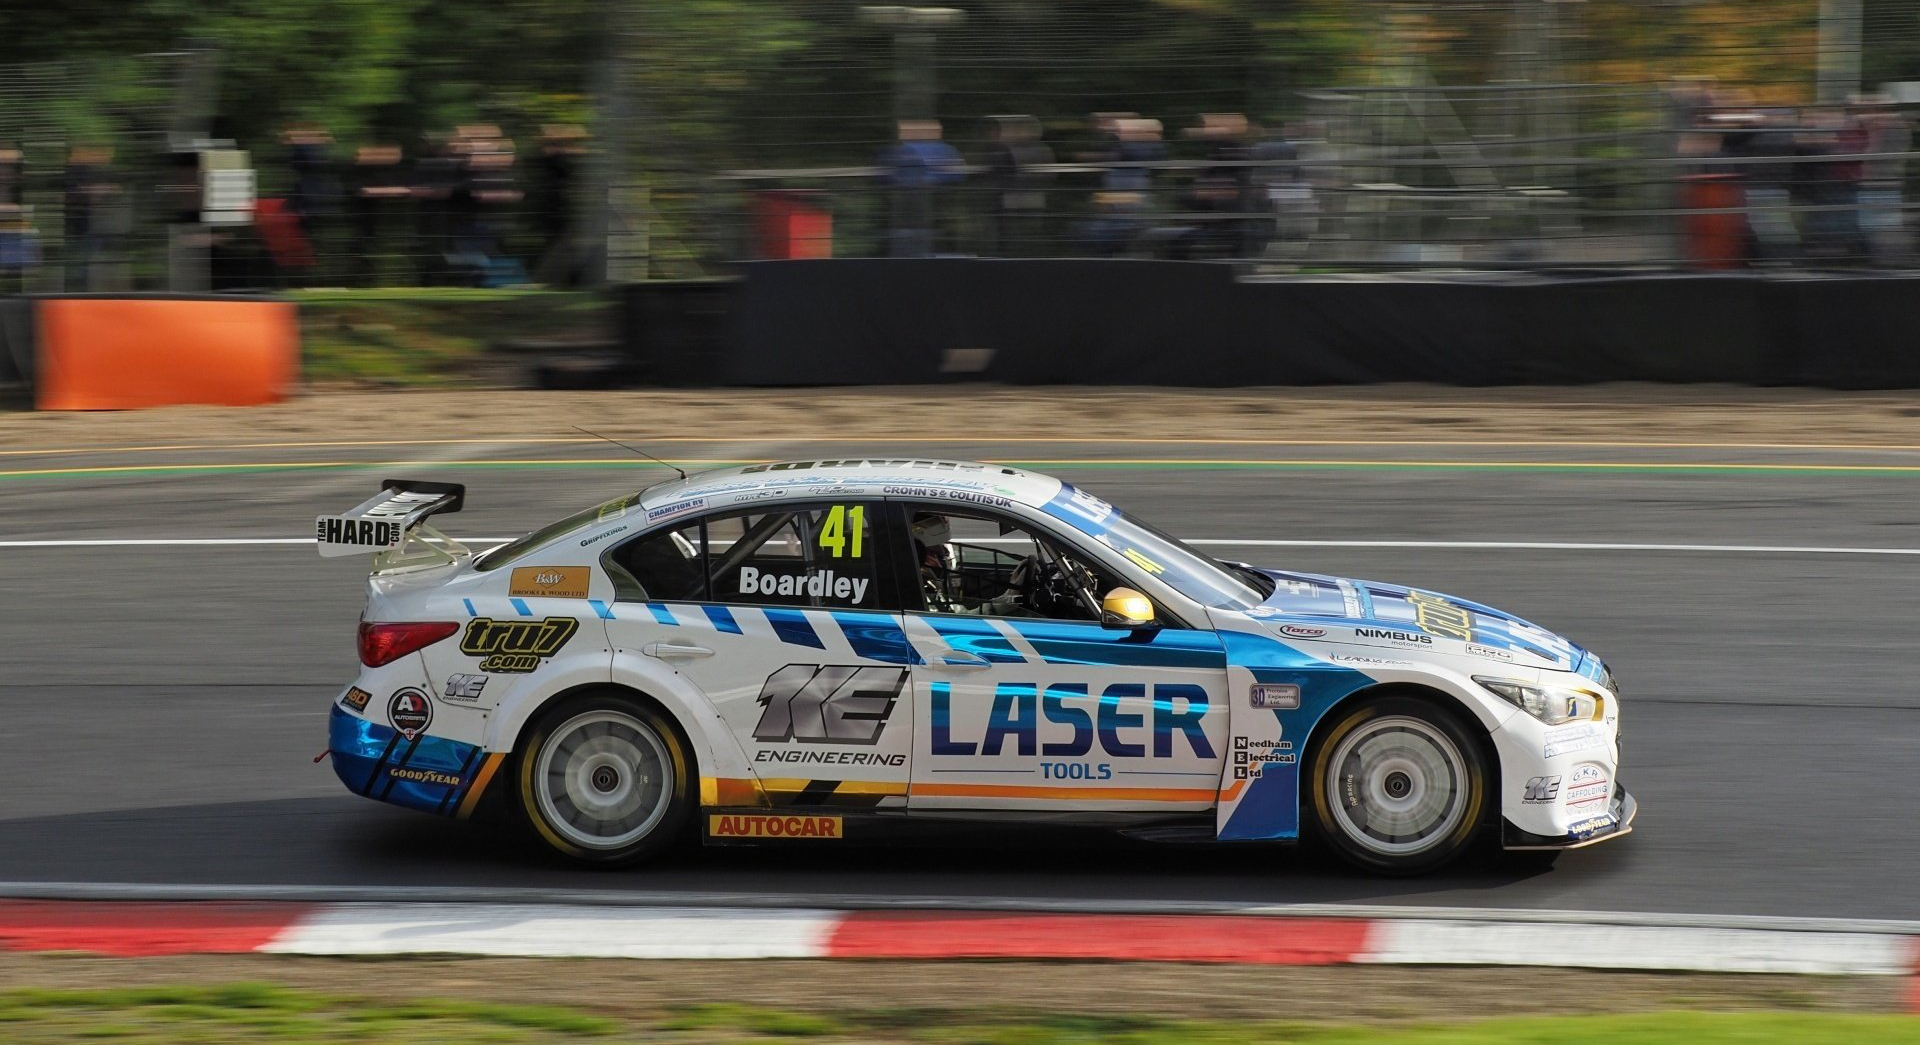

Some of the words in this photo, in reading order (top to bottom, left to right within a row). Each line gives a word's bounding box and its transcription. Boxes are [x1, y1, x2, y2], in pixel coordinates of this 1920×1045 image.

[883, 485, 938, 496] CROHN'S
[949, 490, 994, 505] COLITIS
[995, 497, 1012, 508] UK
[648, 501, 691, 519] CHAMPION
[326, 518, 390, 546] HARD
[819, 505, 864, 558] 41
[739, 566, 869, 604] Boardley
[460, 617, 579, 656] tru7
[1355, 628, 1433, 644] NIMBUS
[1391, 640, 1433, 650] motorsport
[1252, 688, 1265, 706] 3D
[931, 681, 1218, 759] LASER
[1235, 738, 1292, 749] Needham
[754, 750, 907, 766] ENGINEERING
[1235, 753, 1295, 763] Electrical
[390, 768, 460, 786] GOODYEAR
[1040, 762, 1112, 780] TOOLS
[1235, 768, 1262, 779] Ltd
[717, 816, 836, 837] AUTOCAR
